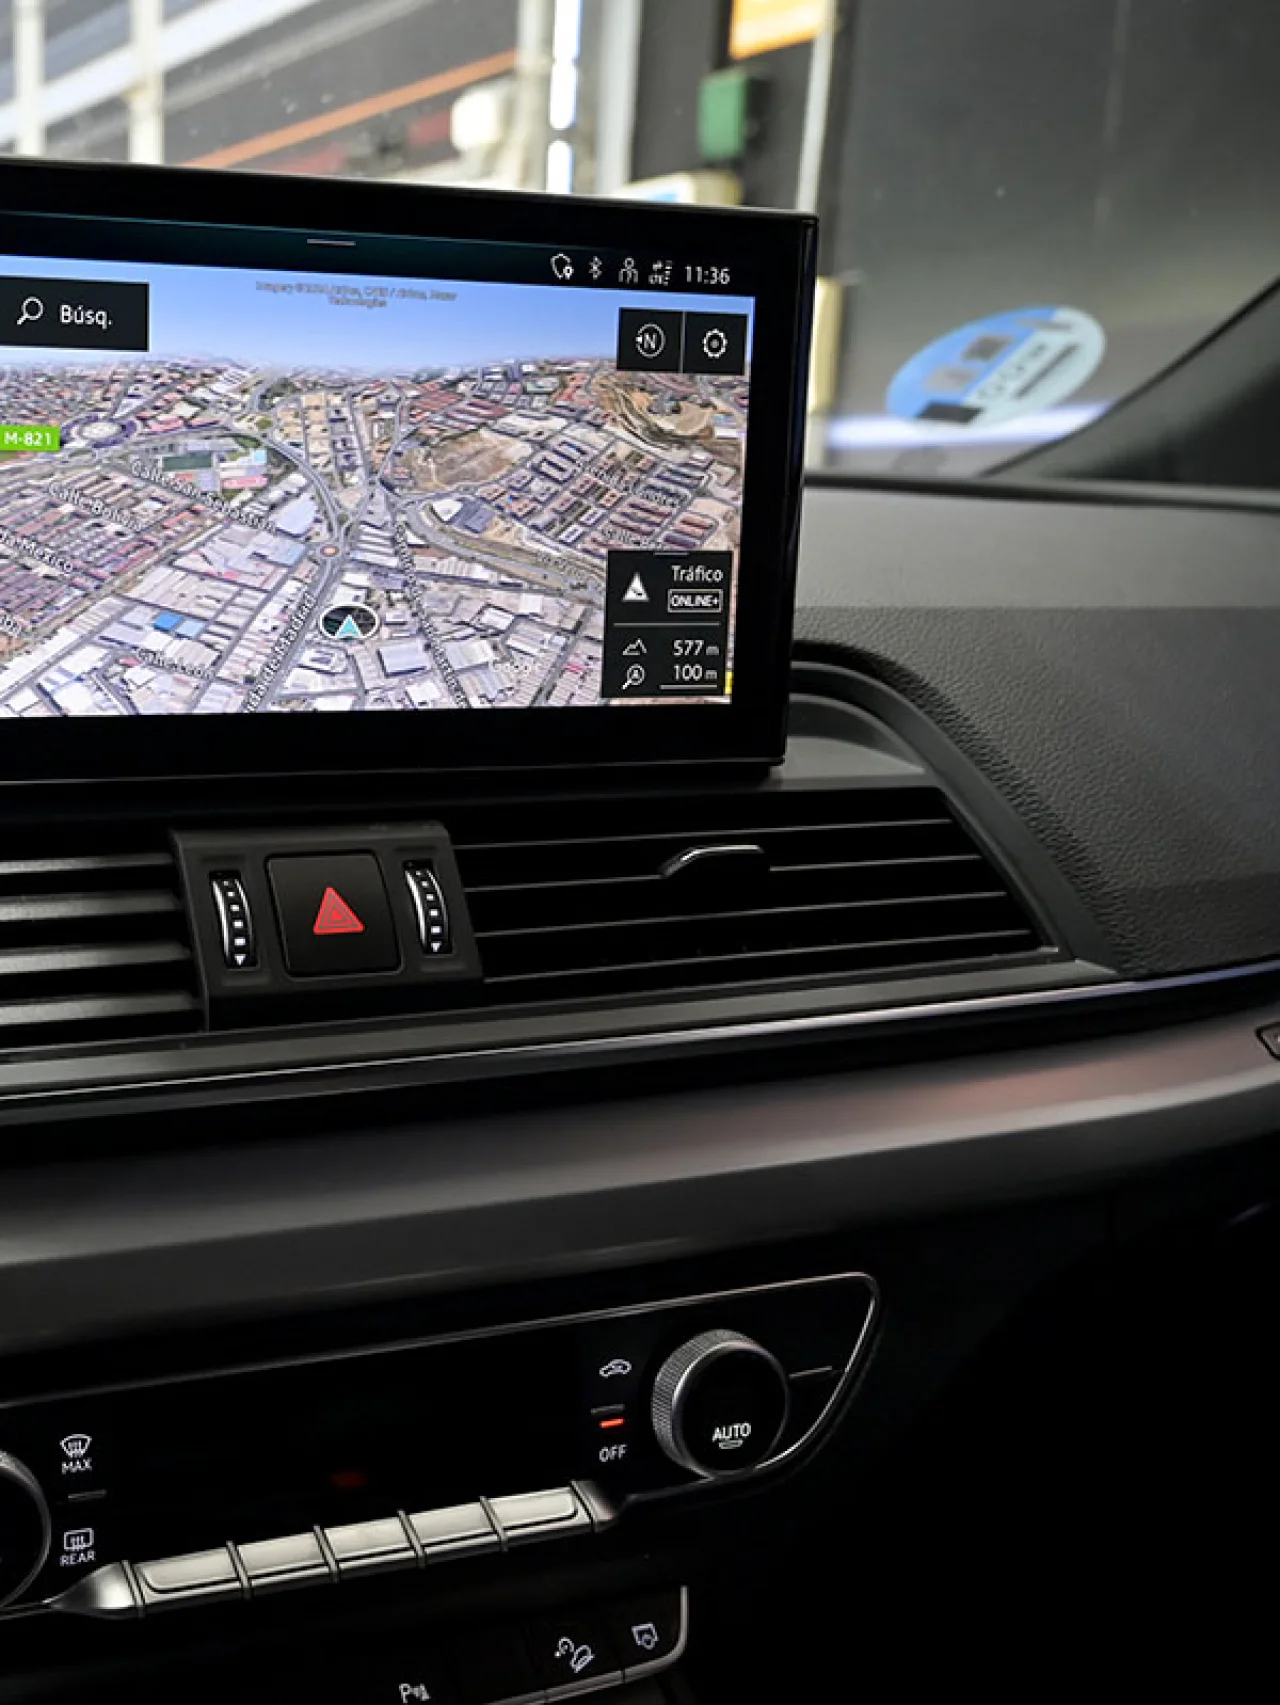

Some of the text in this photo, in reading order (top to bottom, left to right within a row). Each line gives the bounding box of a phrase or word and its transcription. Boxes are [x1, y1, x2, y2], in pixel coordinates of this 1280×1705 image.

[685, 265, 730, 285] 11:36
[60, 304, 113, 330] Búsq.
[643, 331, 658, 350] N
[4, 431, 52, 445] M-821
[671, 565, 723, 583] Tráfico
[671, 595, 719, 608] ONLINE+
[673, 640, 719, 656] 577 m
[674, 665, 717, 680] 100 m
[712, 1421, 752, 1443] AUTO
[599, 1443, 627, 1462] OFF
[61, 1457, 93, 1475] MAX
[59, 1550, 96, 1567] REAR
